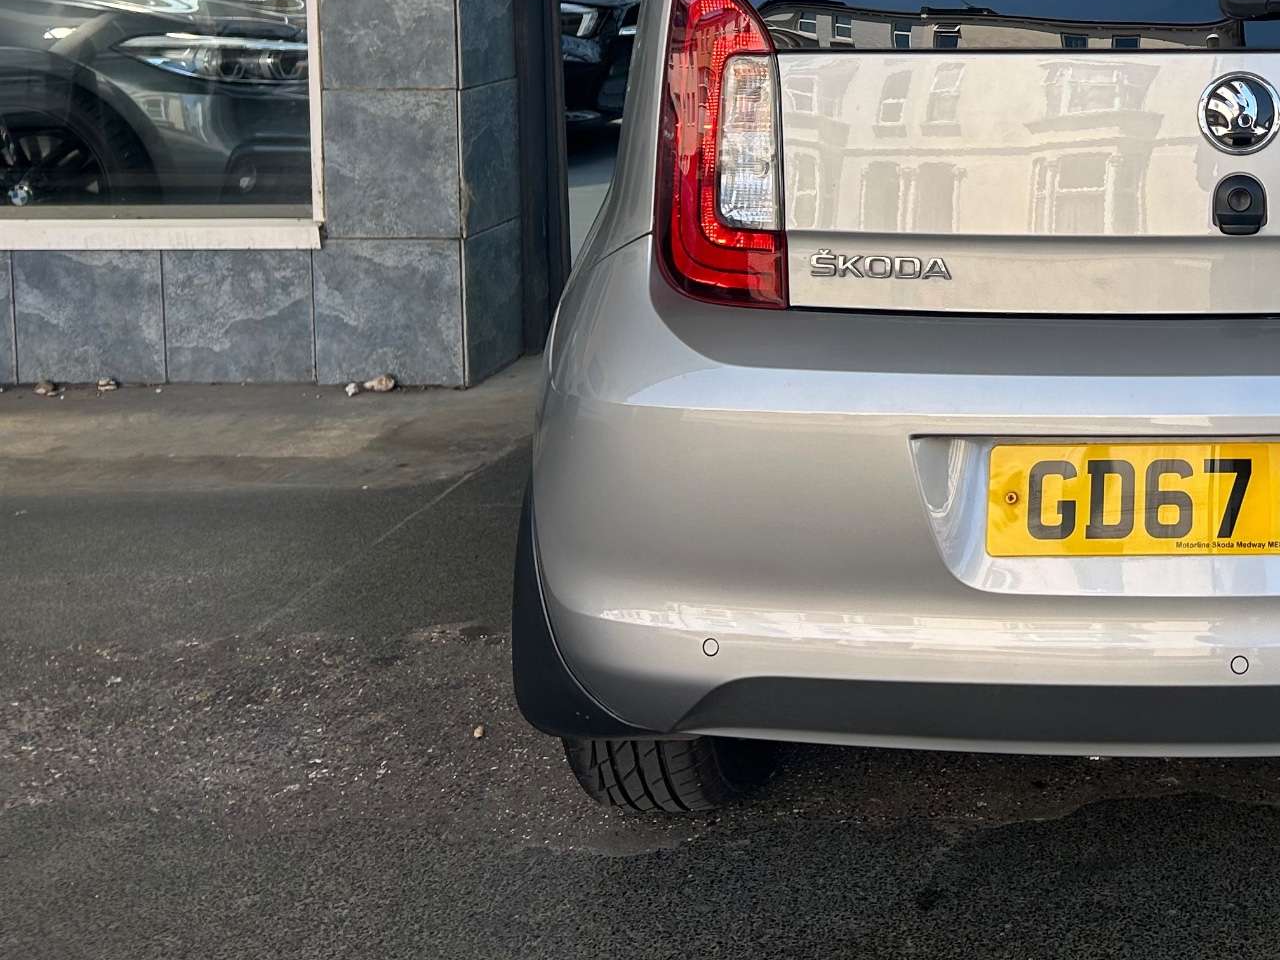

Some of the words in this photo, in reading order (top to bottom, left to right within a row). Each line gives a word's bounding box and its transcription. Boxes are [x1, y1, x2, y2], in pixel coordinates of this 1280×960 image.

[810, 248, 952, 281] ŠKODA
[1027, 458, 1253, 540] GD67
[1175, 541, 1210, 549] Motorline
[1236, 541, 1266, 550] Medway
